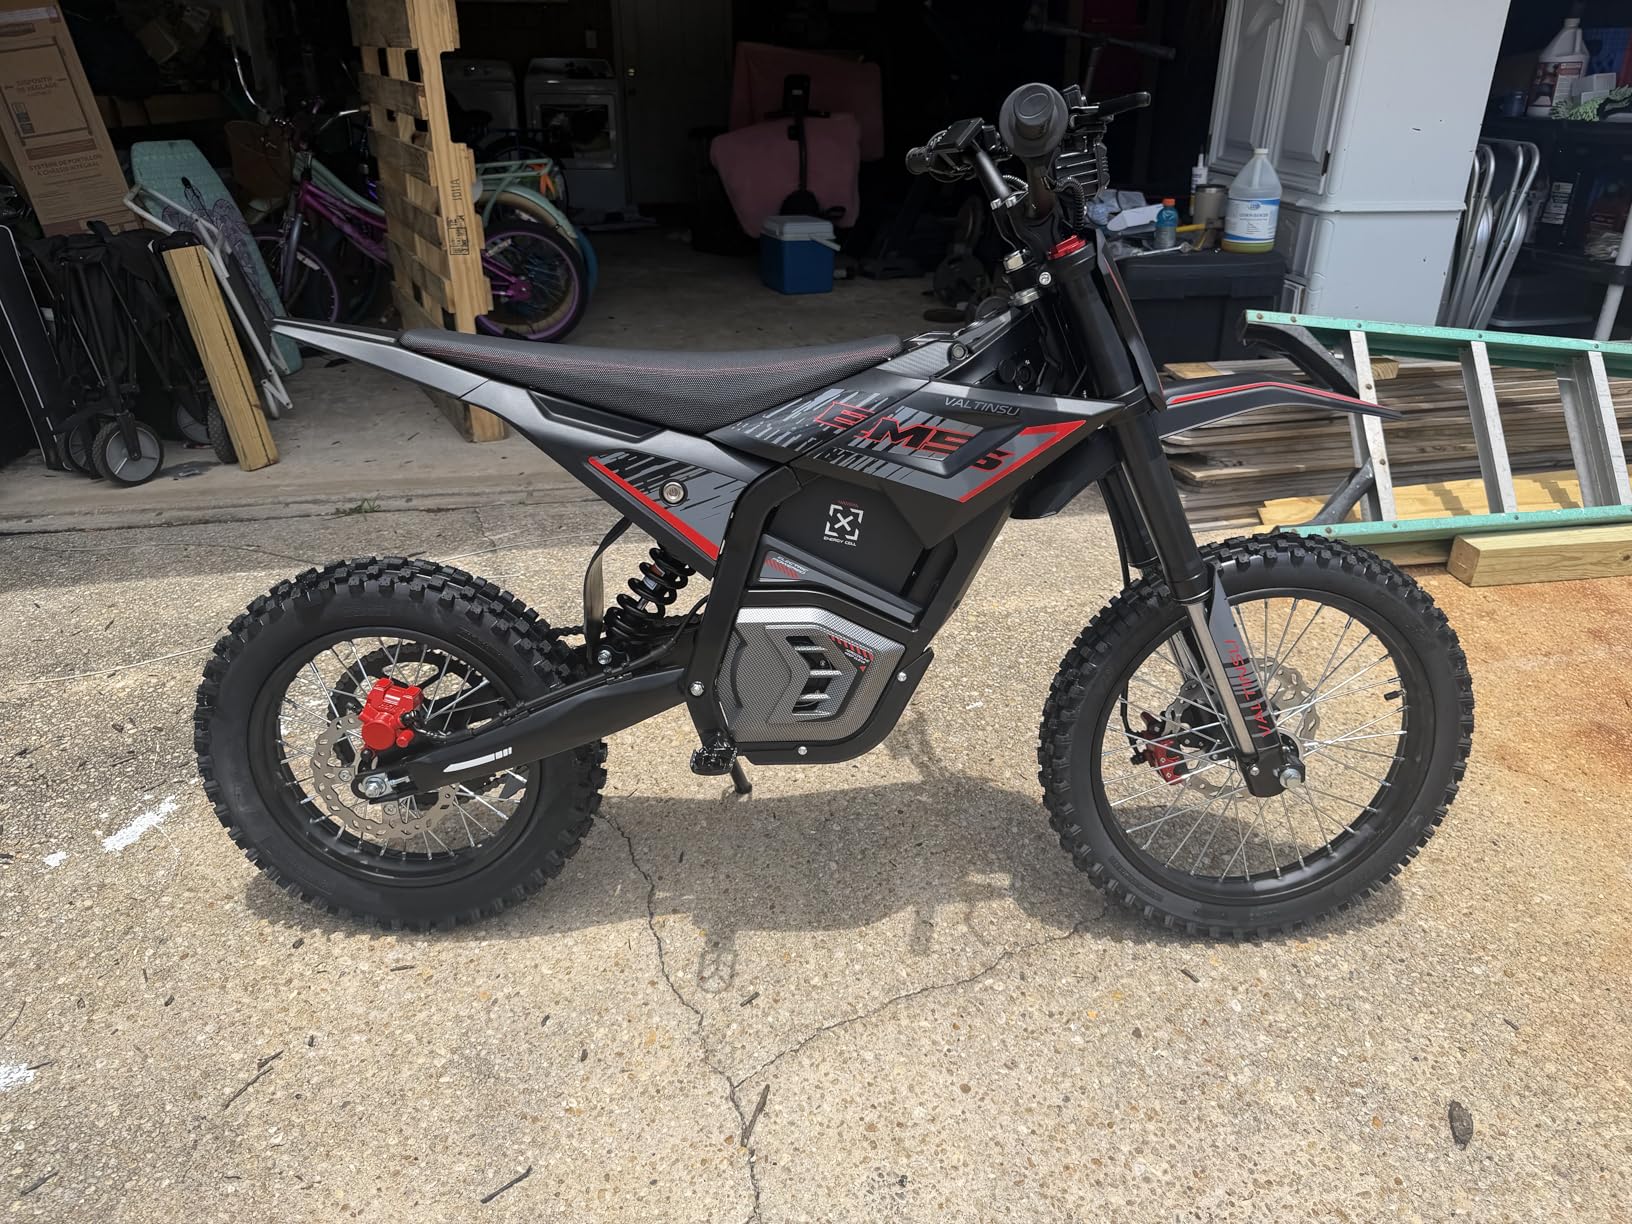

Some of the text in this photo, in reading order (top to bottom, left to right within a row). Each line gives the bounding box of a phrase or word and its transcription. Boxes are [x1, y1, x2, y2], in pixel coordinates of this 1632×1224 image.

[944, 397, 1020, 417] VALTINSU
[823, 536, 857, 547] ENERGY CELL
[1223, 639, 1272, 738] VALTINSU
